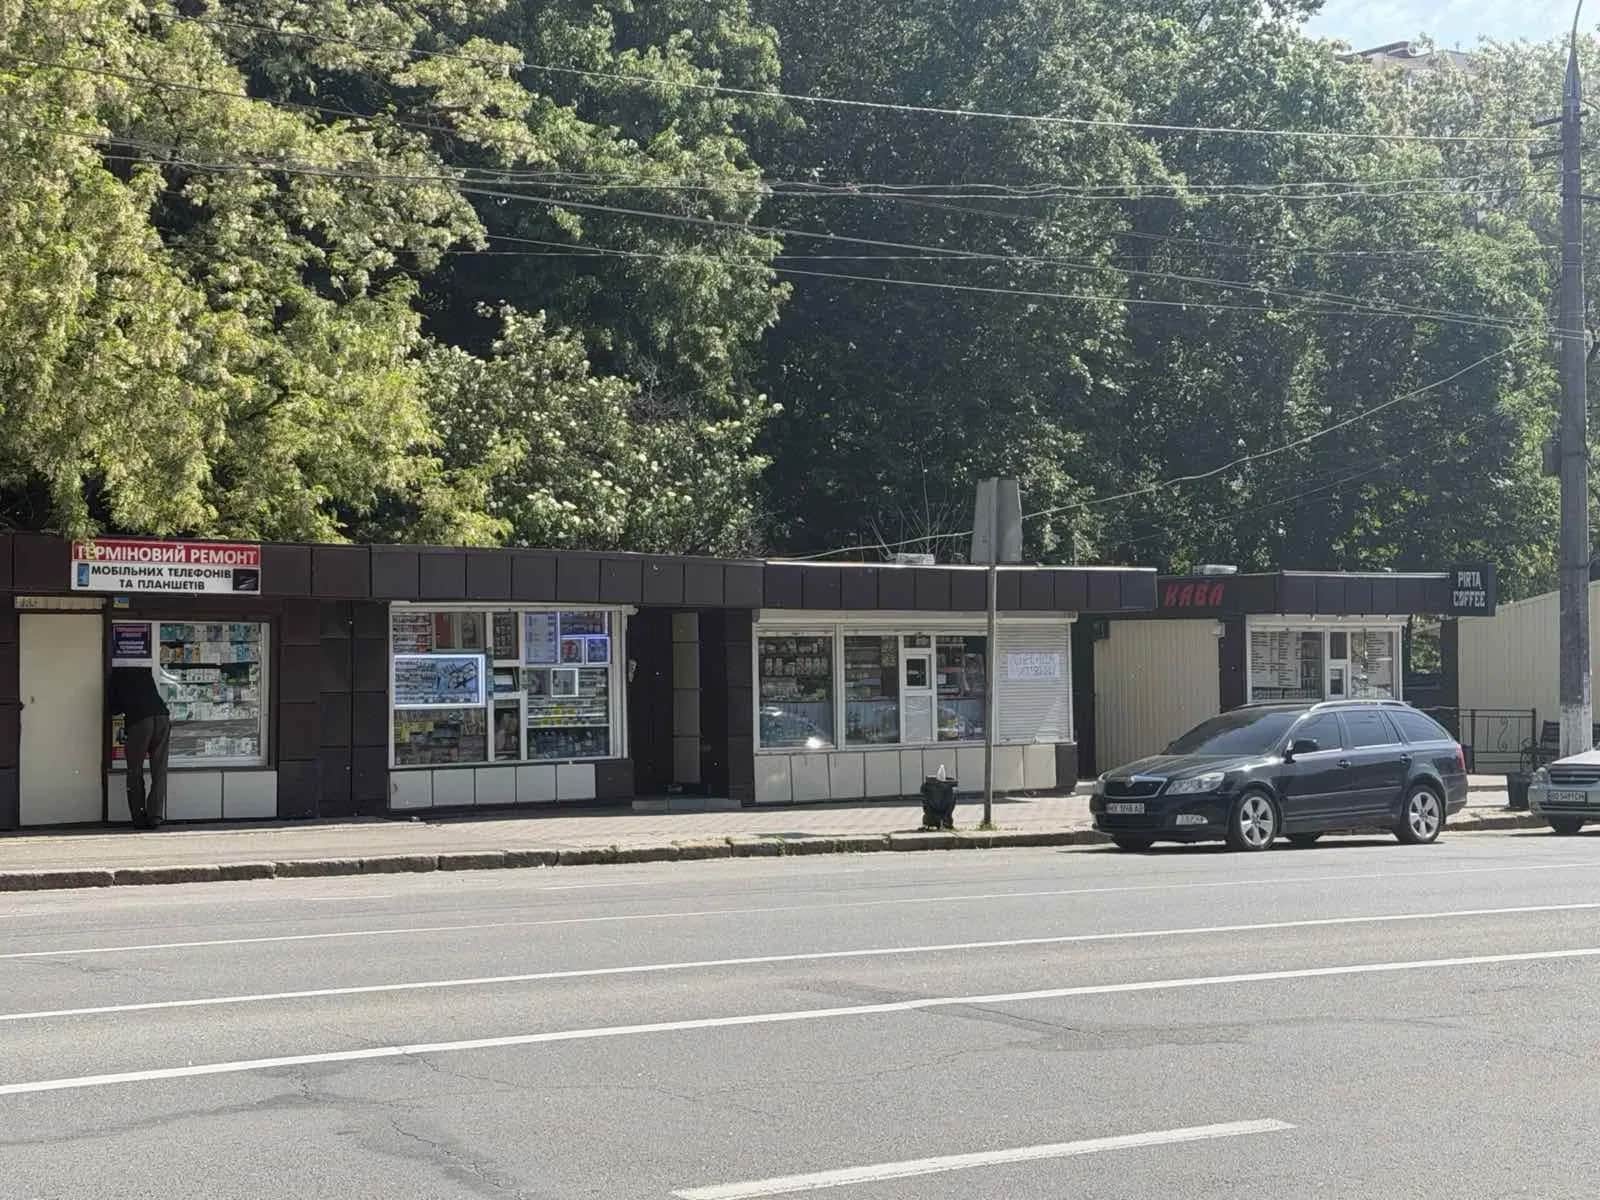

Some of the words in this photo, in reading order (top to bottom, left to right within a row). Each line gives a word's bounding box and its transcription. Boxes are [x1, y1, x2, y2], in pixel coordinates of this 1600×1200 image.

[190, 550, 257, 564] РЕМОНТ
[91, 565, 164, 577] МОБІЛЬНИХ
[168, 568, 232, 579] ТЕЛЕФОНІВ
[119, 579, 134, 588] ТА
[137, 580, 206, 590] ПЛАНШЕТІВ
[1457, 571, 1481, 588] PIRTA
